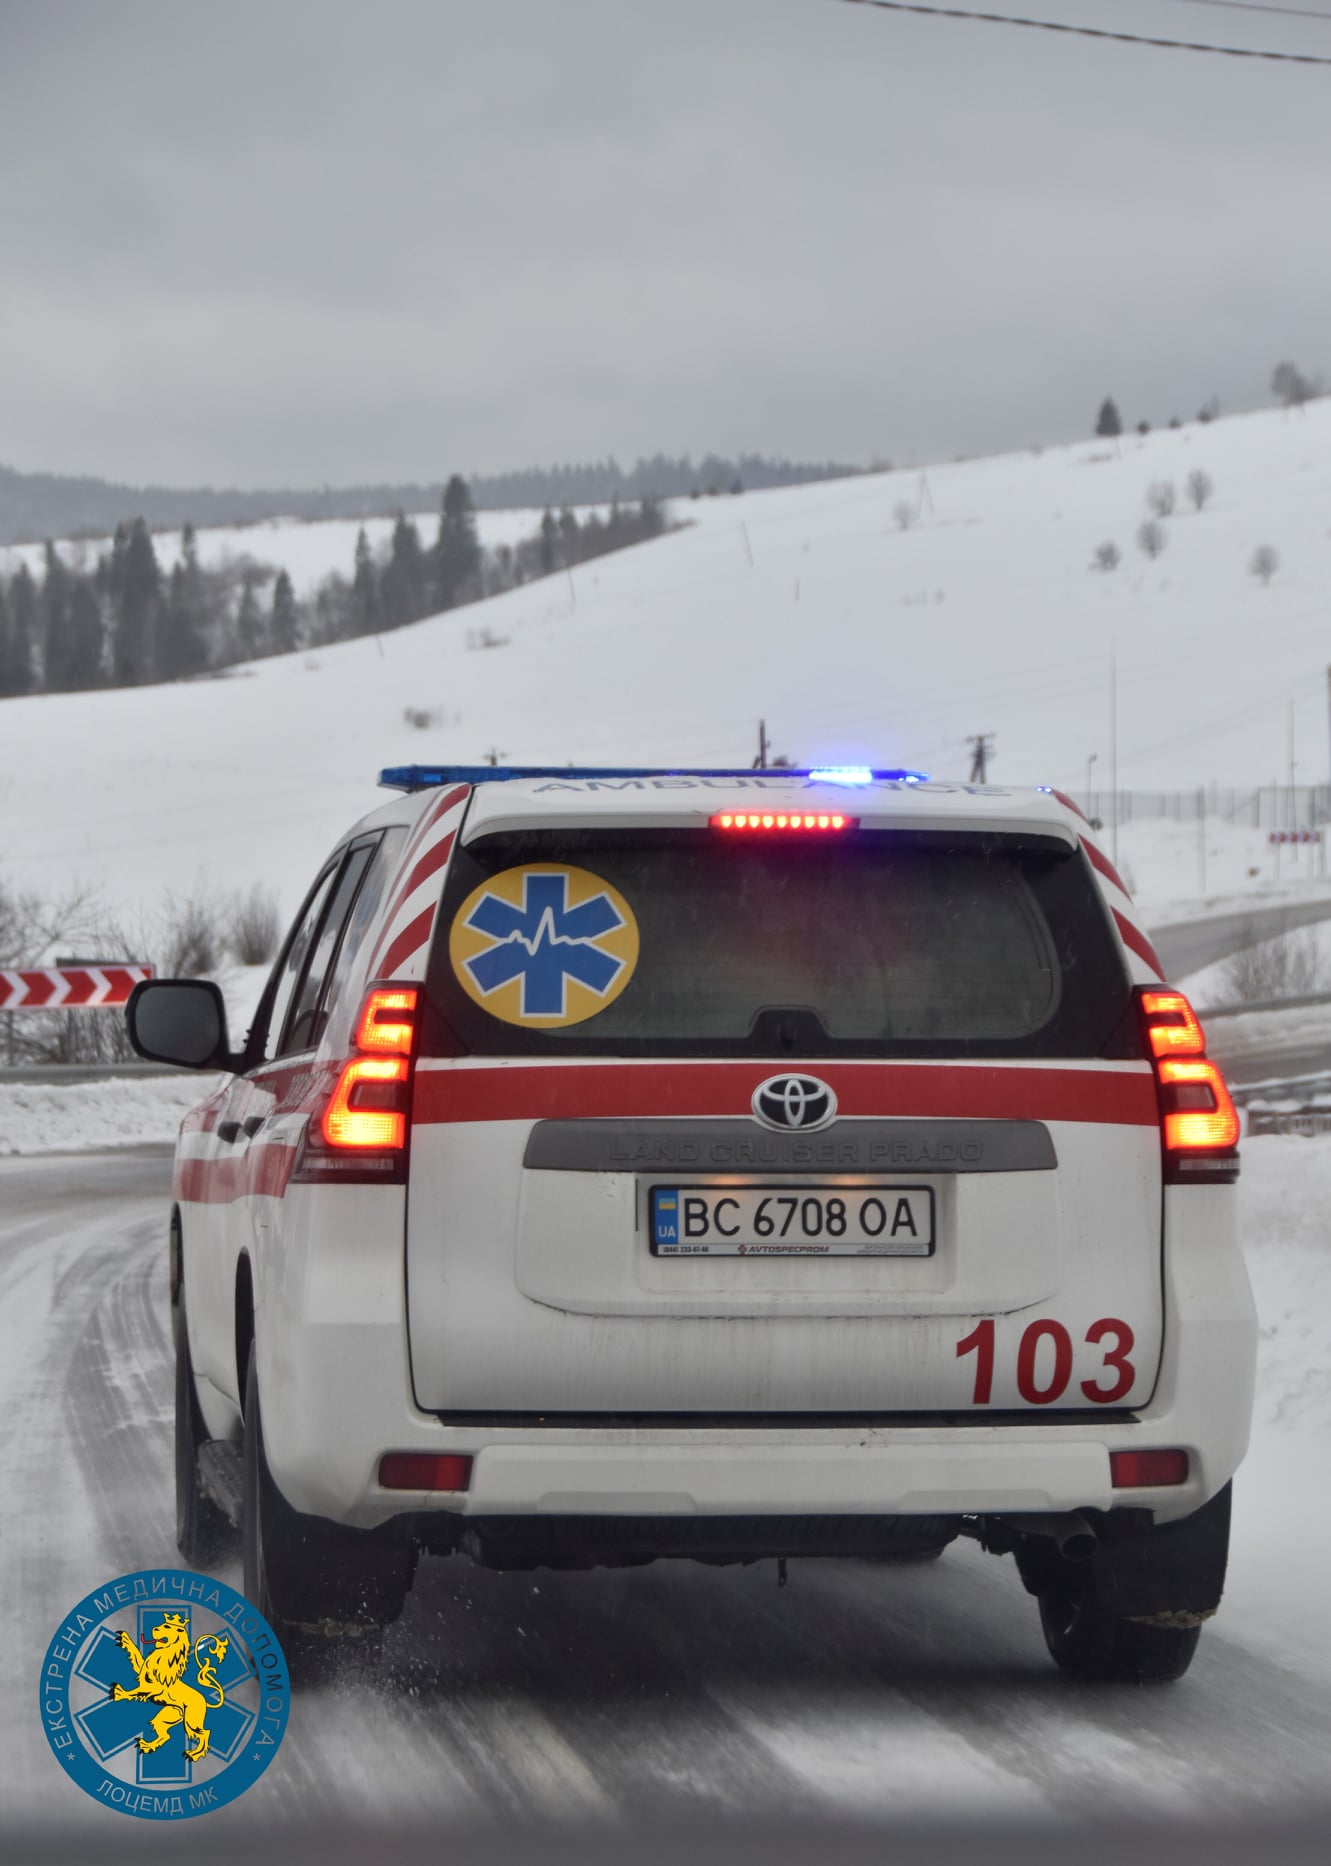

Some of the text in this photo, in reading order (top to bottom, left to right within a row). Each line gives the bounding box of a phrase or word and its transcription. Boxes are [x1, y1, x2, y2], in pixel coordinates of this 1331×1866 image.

[533, 779, 1013, 796] AMBULANCE
[609, 1140, 984, 1162] LAND CRUISER PRADO
[684, 1197, 918, 1237] BC 6708 OA
[658, 1225, 676, 1238] UA
[956, 1318, 1136, 1404] 103
